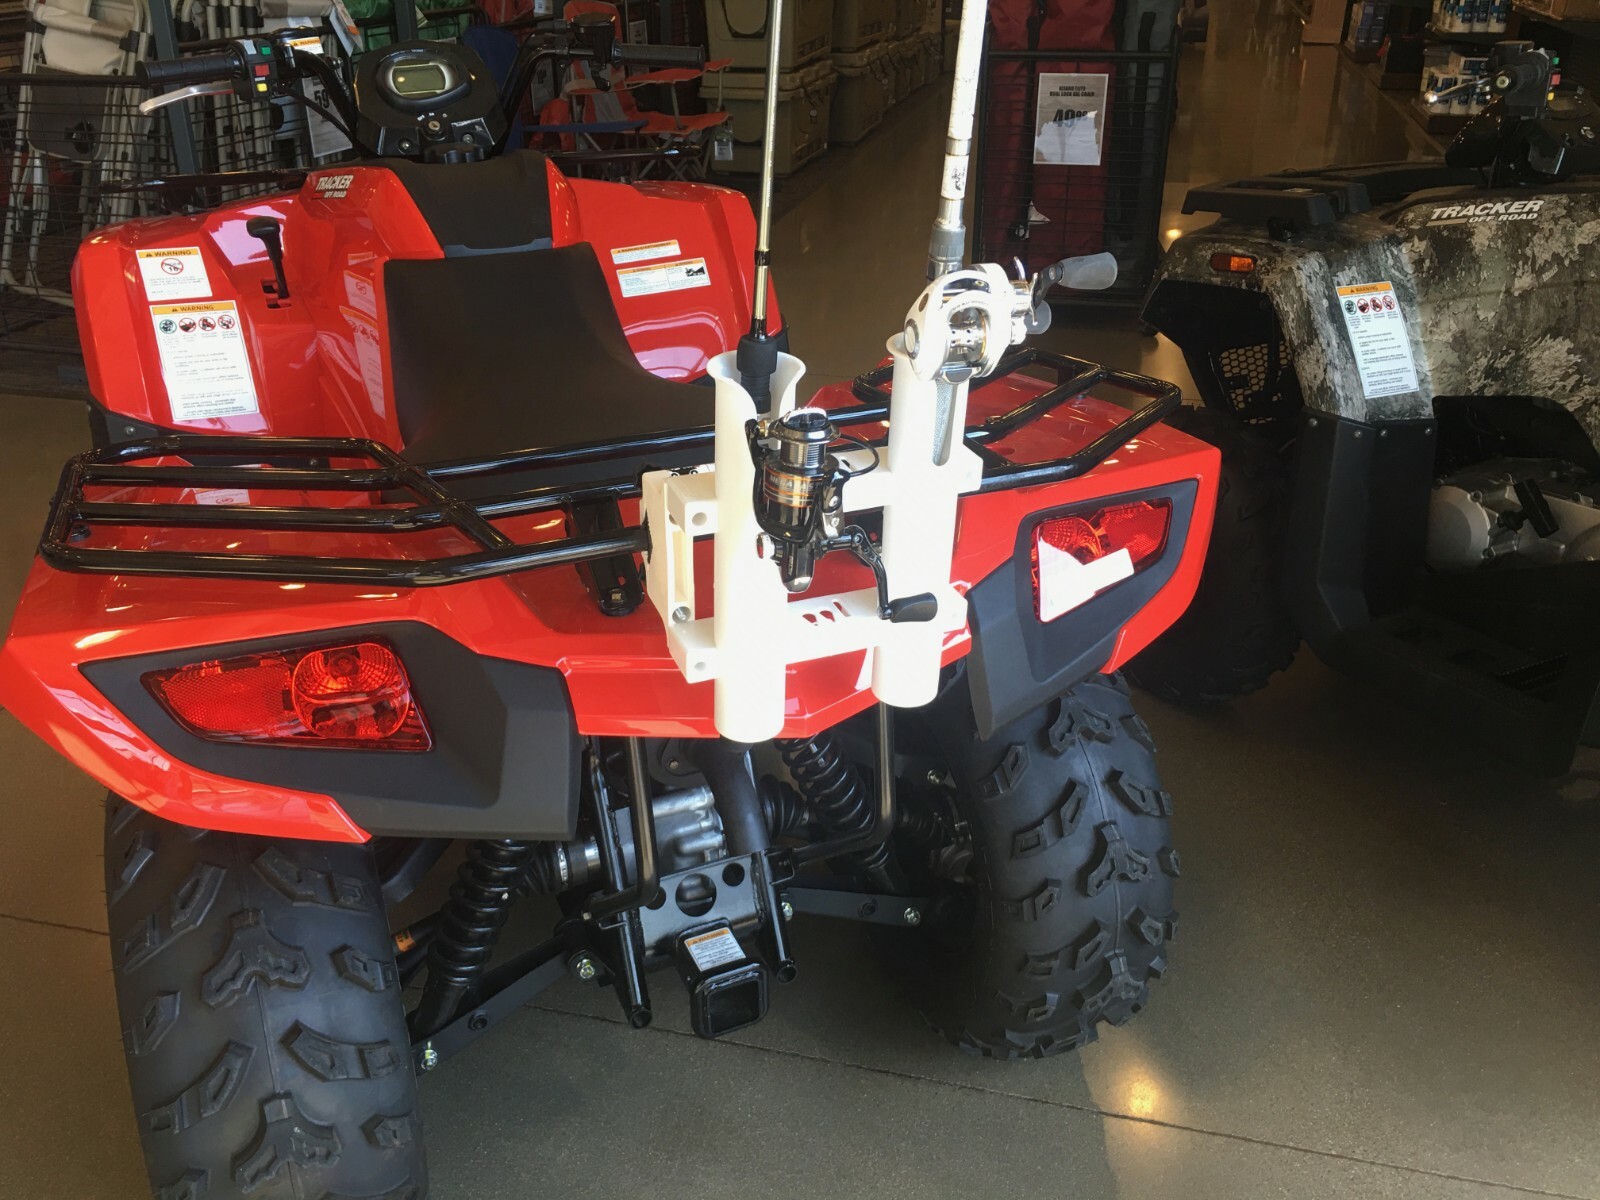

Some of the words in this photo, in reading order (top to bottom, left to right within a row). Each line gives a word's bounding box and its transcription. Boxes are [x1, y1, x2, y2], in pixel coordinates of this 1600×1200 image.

[316, 174, 354, 191] TRACKER
[333, 190, 347, 198] ROAD
[1430, 200, 1545, 220] TRACKER
[1469, 215, 1496, 223] OFF
[1498, 213, 1539, 221] ROAD
[154, 249, 192, 257] WARNING
[180, 304, 214, 312] WARNING
